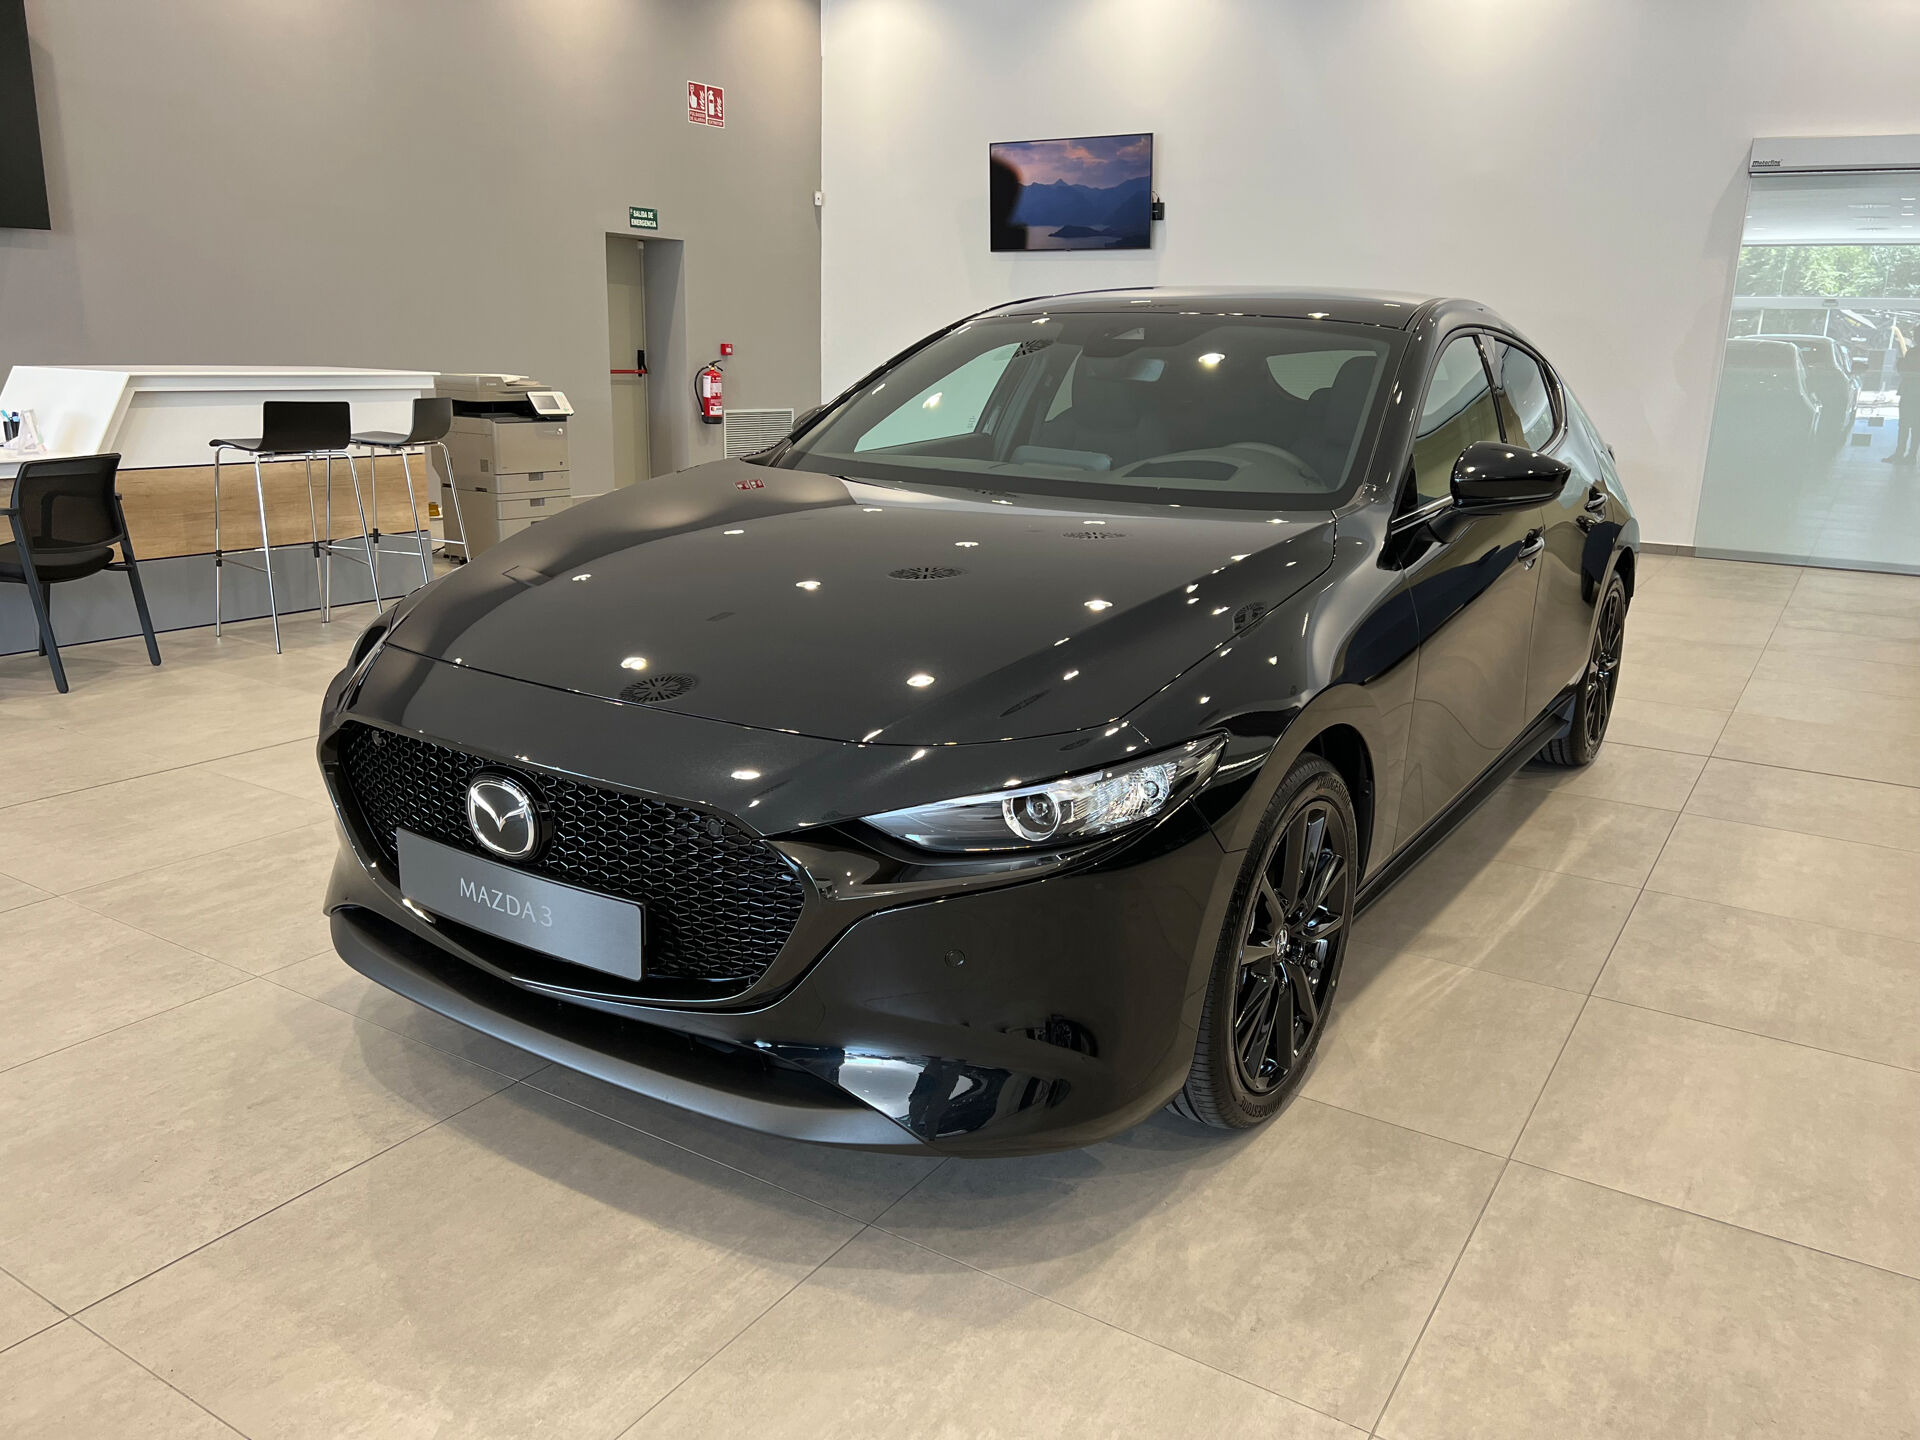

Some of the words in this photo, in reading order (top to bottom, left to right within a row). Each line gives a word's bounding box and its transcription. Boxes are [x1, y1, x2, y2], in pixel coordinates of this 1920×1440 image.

[633, 210, 648, 218] SALIDA
[647, 211, 654, 219] DE
[631, 218, 657, 227] EMERGENCIA
[460, 877, 537, 923] MAZDA
[540, 905, 553, 928] 3
